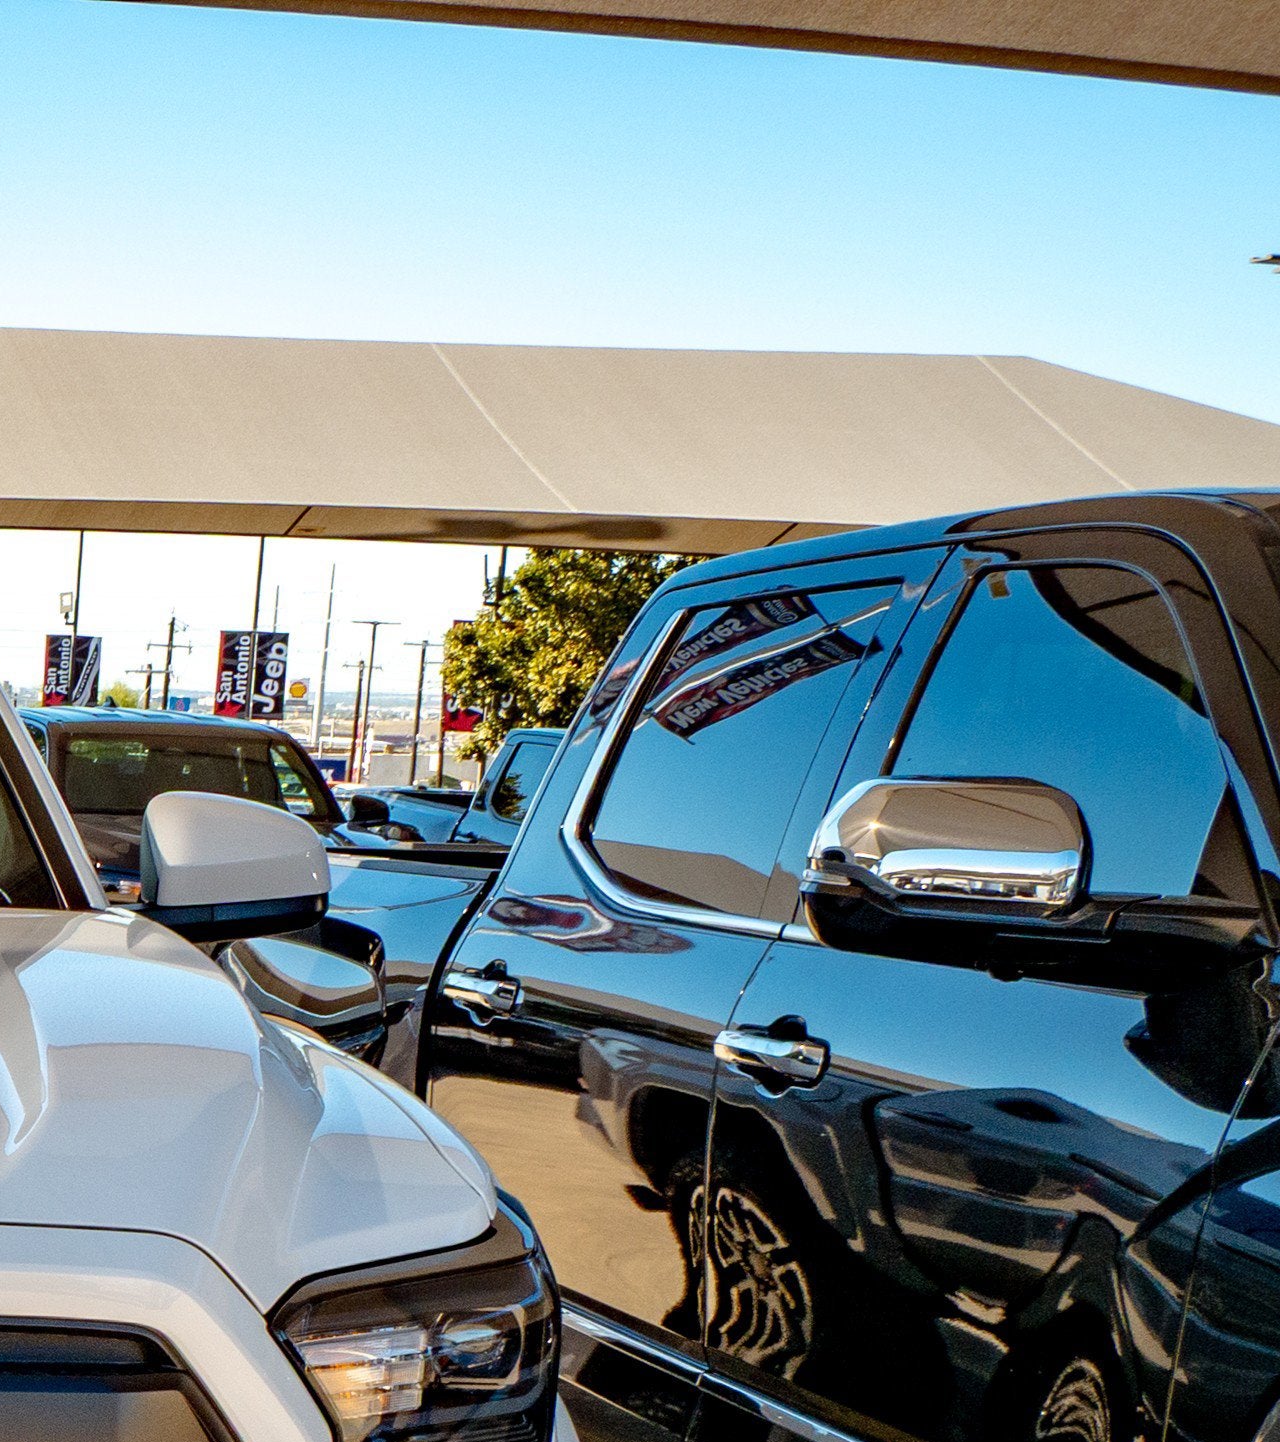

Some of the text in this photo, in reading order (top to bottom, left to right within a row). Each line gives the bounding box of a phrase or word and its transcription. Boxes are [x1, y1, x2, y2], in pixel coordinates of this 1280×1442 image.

[44, 667, 57, 695] San
[56, 638, 71, 695] Antonio
[216, 670, 233, 704] San
[232, 635, 251, 705] Antonio
[253, 642, 288, 713] Jeep
